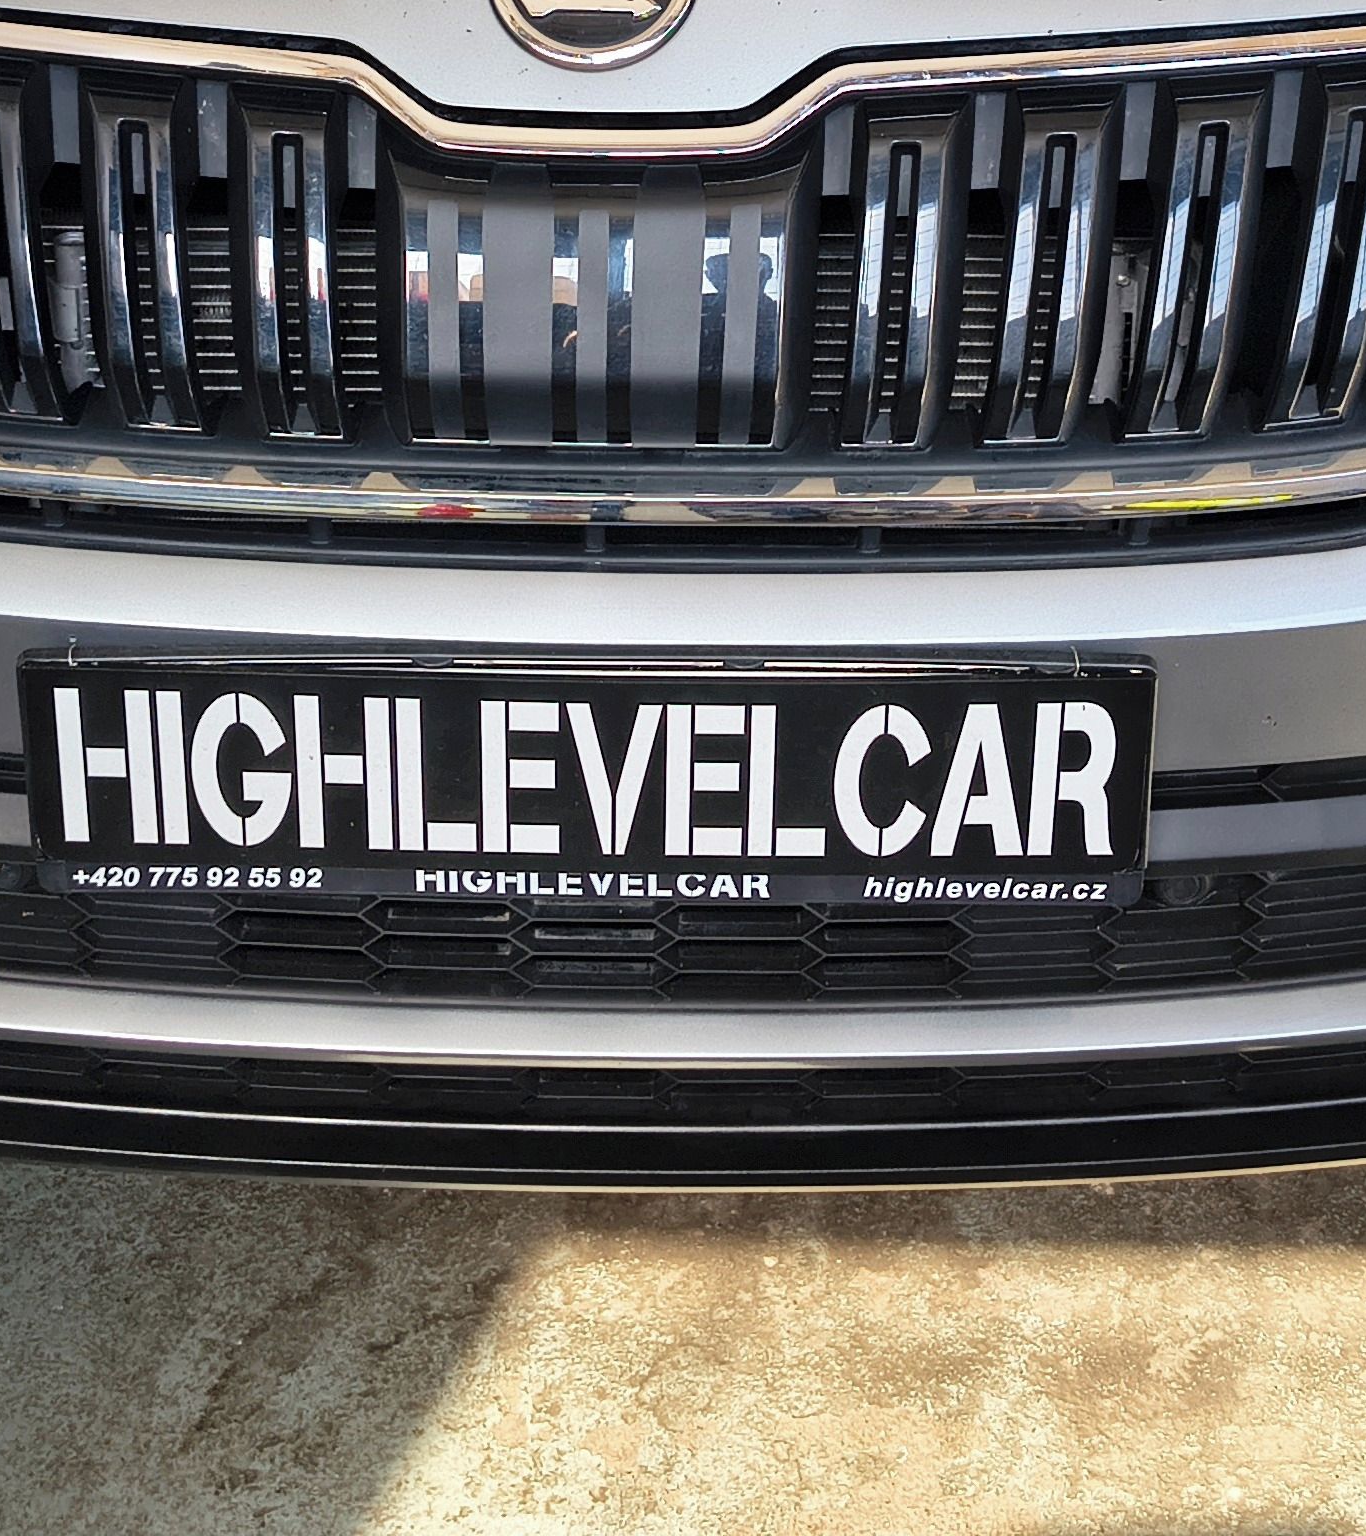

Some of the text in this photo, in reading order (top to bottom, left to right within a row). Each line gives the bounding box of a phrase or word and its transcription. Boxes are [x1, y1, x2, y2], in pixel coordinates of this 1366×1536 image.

[71, 866, 323, 888] +420 775 92 55 92
[415, 869, 771, 899] HIGHLEVELCAR
[863, 876, 1108, 903] highlevelcar.cz
